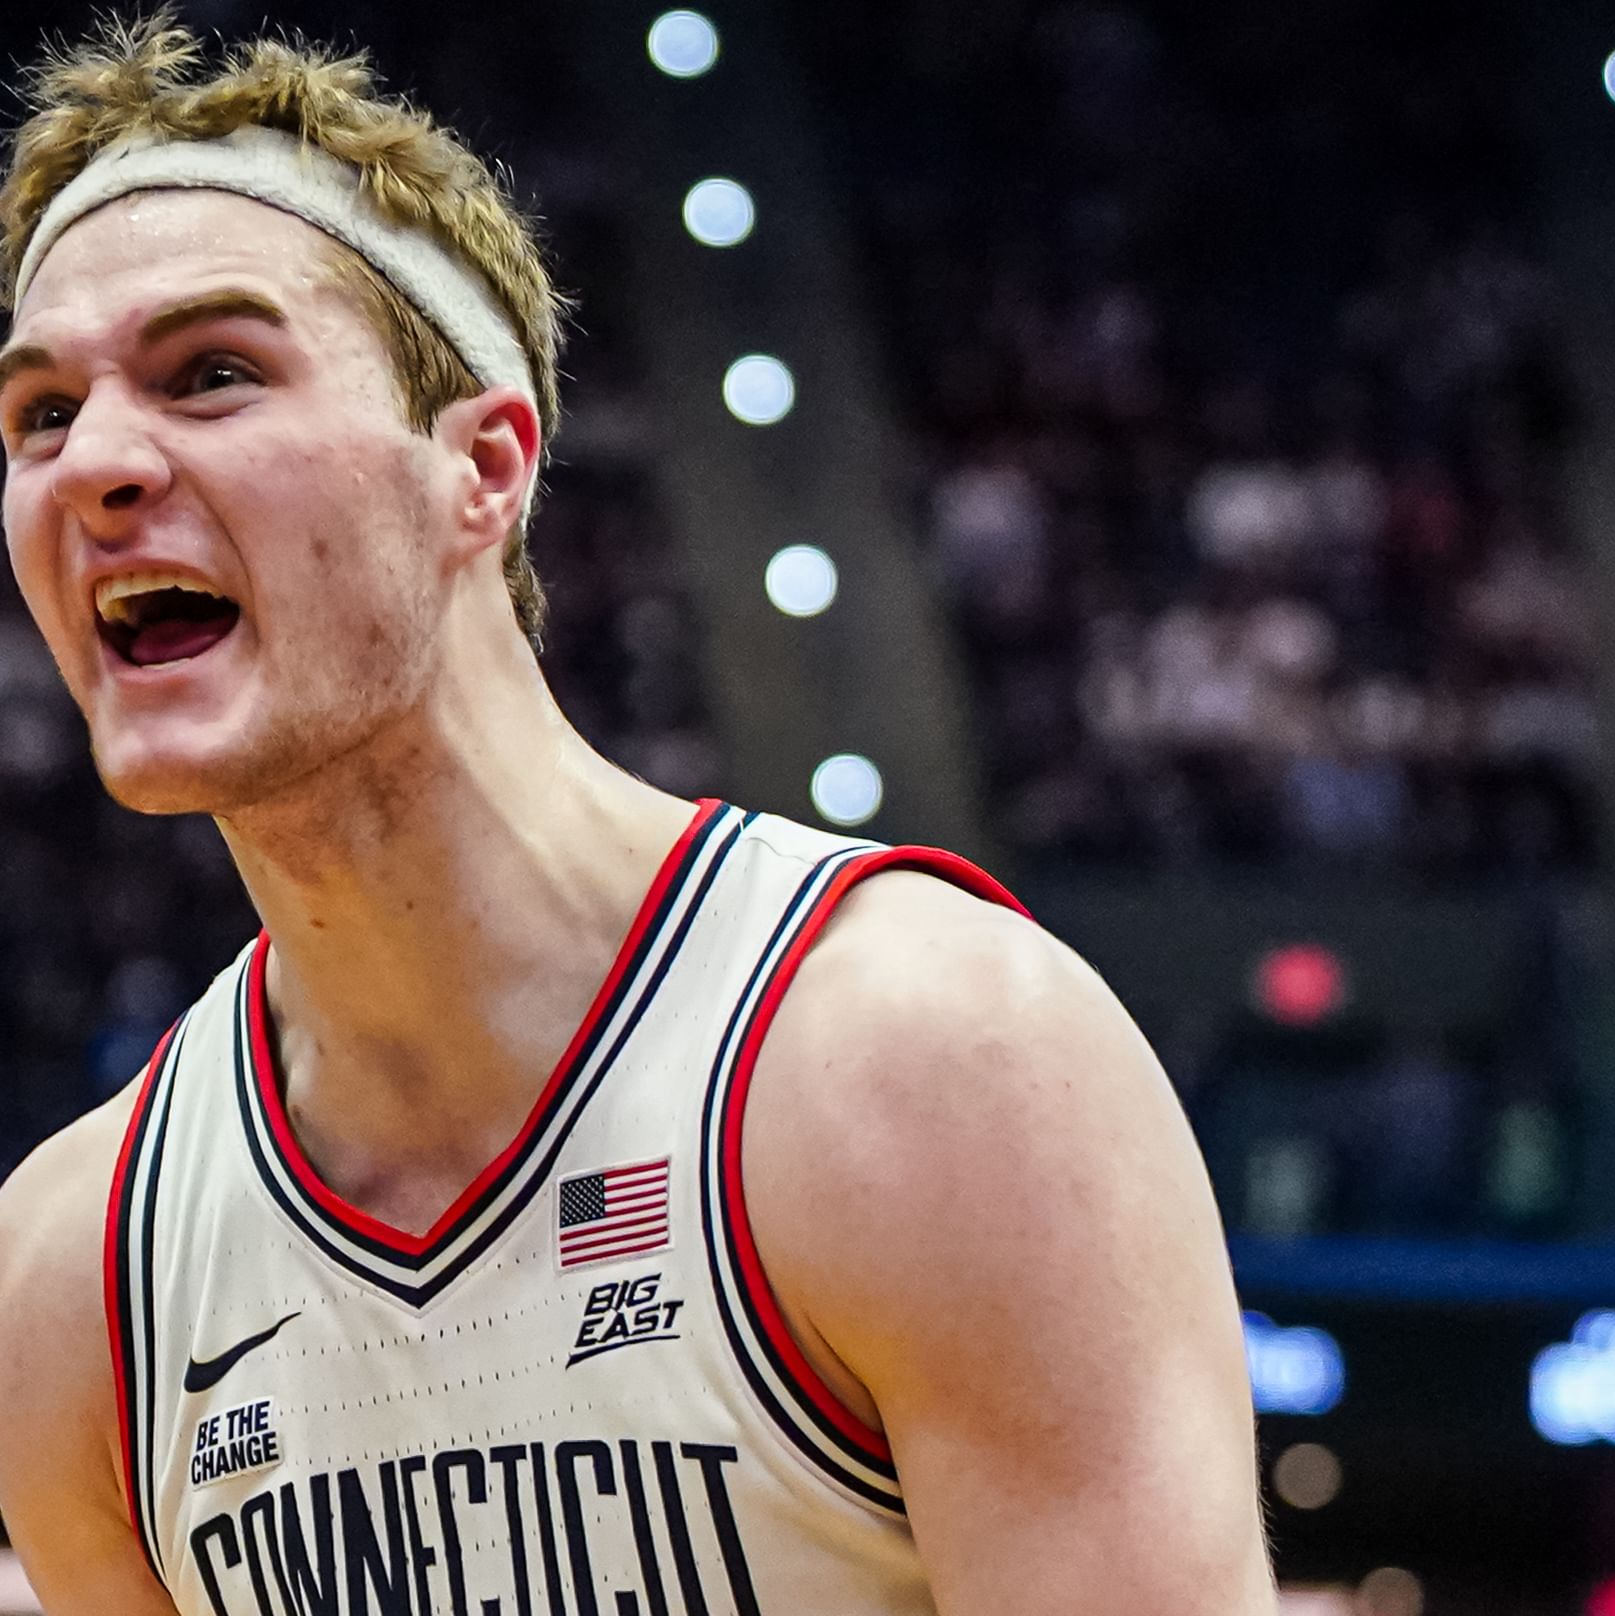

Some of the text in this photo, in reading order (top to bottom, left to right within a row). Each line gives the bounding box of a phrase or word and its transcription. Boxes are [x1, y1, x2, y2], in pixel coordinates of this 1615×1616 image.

[584, 1272, 662, 1316] BIG
[574, 1300, 684, 1348] EAST
[196, 1400, 270, 1452] BE THE
[191, 1431, 279, 1485] CHANGE
